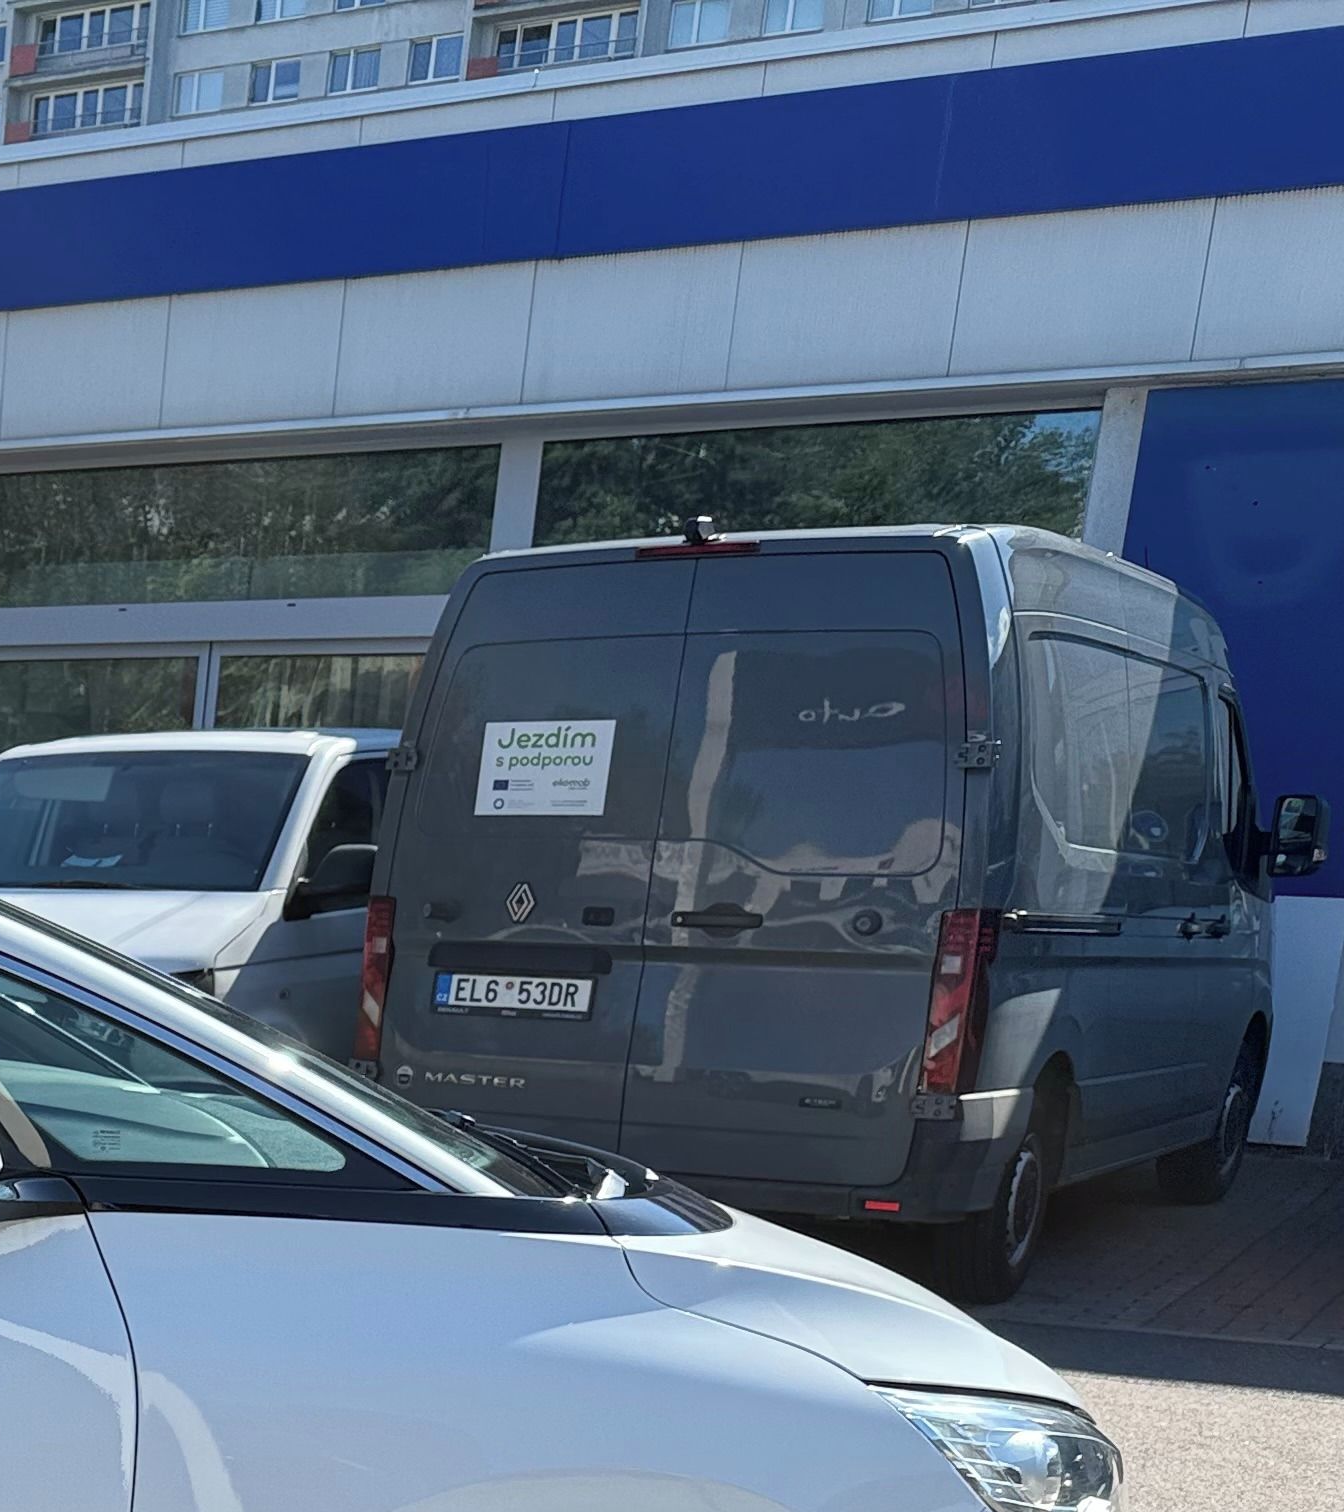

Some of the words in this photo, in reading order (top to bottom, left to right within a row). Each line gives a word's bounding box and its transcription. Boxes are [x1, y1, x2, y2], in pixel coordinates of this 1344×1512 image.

[497, 725, 596, 749] Jezdím
[496, 756, 504, 767] s
[508, 752, 593, 771] podporou
[436, 992, 448, 1002] CZ
[454, 978, 499, 1003] EL6
[517, 980, 579, 1008] 53DR
[424, 1071, 526, 1088] MASTER
